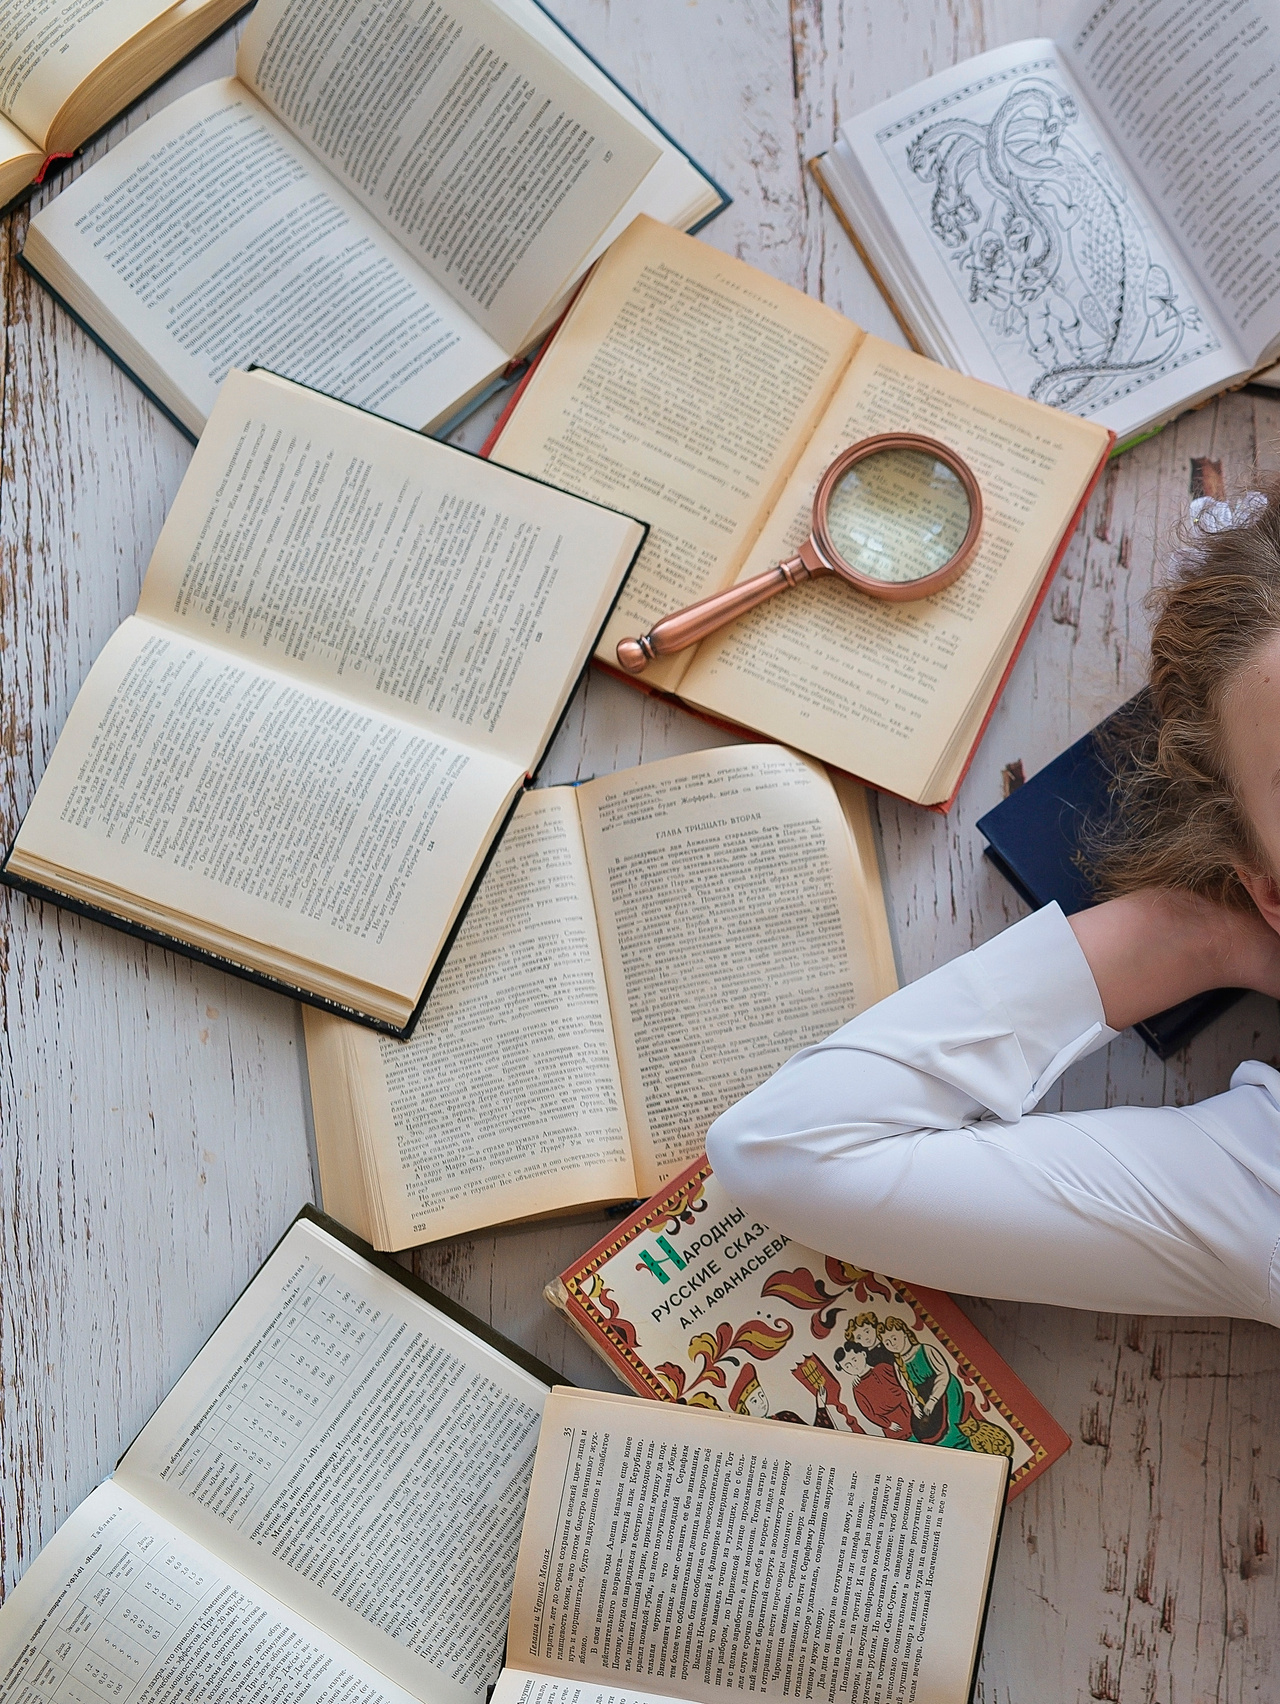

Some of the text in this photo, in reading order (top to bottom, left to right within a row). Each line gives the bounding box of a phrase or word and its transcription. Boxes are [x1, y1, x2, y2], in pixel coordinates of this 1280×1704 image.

[655, 812, 762, 840] ГЛАВА ТРИДЦАТЬ ВТОРАЯ
[412, 1222, 427, 1233] 322
[639, 1206, 749, 1285] НАРОДНЫ
[651, 1259, 722, 1323] РУССКИЕ
[679, 1233, 793, 1330] А.Н. АФАНАСЬЕВА
[563, 1427, 572, 1437] 35
[576, 1438, 586, 1461] лица
[249, 1521, 265, 1541] торце
[262, 1488, 291, 1522] световода,
[286, 1463, 307, 1489] равной
[350, 1366, 377, 1400] облучение
[572, 1461, 582, 1483] цвет
[628, 1438, 644, 1485] Керубино.
[261, 1512, 282, 1539] течение
[288, 1486, 302, 1502] мин.
[270, 1451, 339, 1540] Методика отпуска процедур.
[566, 1484, 578, 1518] свежий
[626, 1488, 636, 1508] паж
[90, 1513, 117, 1539] Таблица
[558, 1519, 572, 1561] сохраняя
[589, 1436, 633, 1655] В свои невеликие годы Алеша казался еще юнее
[620, 1510, 632, 1545] чистый
[557, 1431, 599, 1661] глянцевость кожи, зато потом быстро начинают жух-
[647, 1444, 690, 1675] тельная чертовка, что плотоядный Серафим
[553, 1562, 564, 1592] сорока
[529, 1623, 540, 1657] Пелагия
[538, 1548, 551, 1580] Монах
[549, 1605, 557, 1621] лет
[552, 1592, 561, 1605] до
[545, 1622, 556, 1659] старятся,
[601, 1599, 617, 1668] действительного
